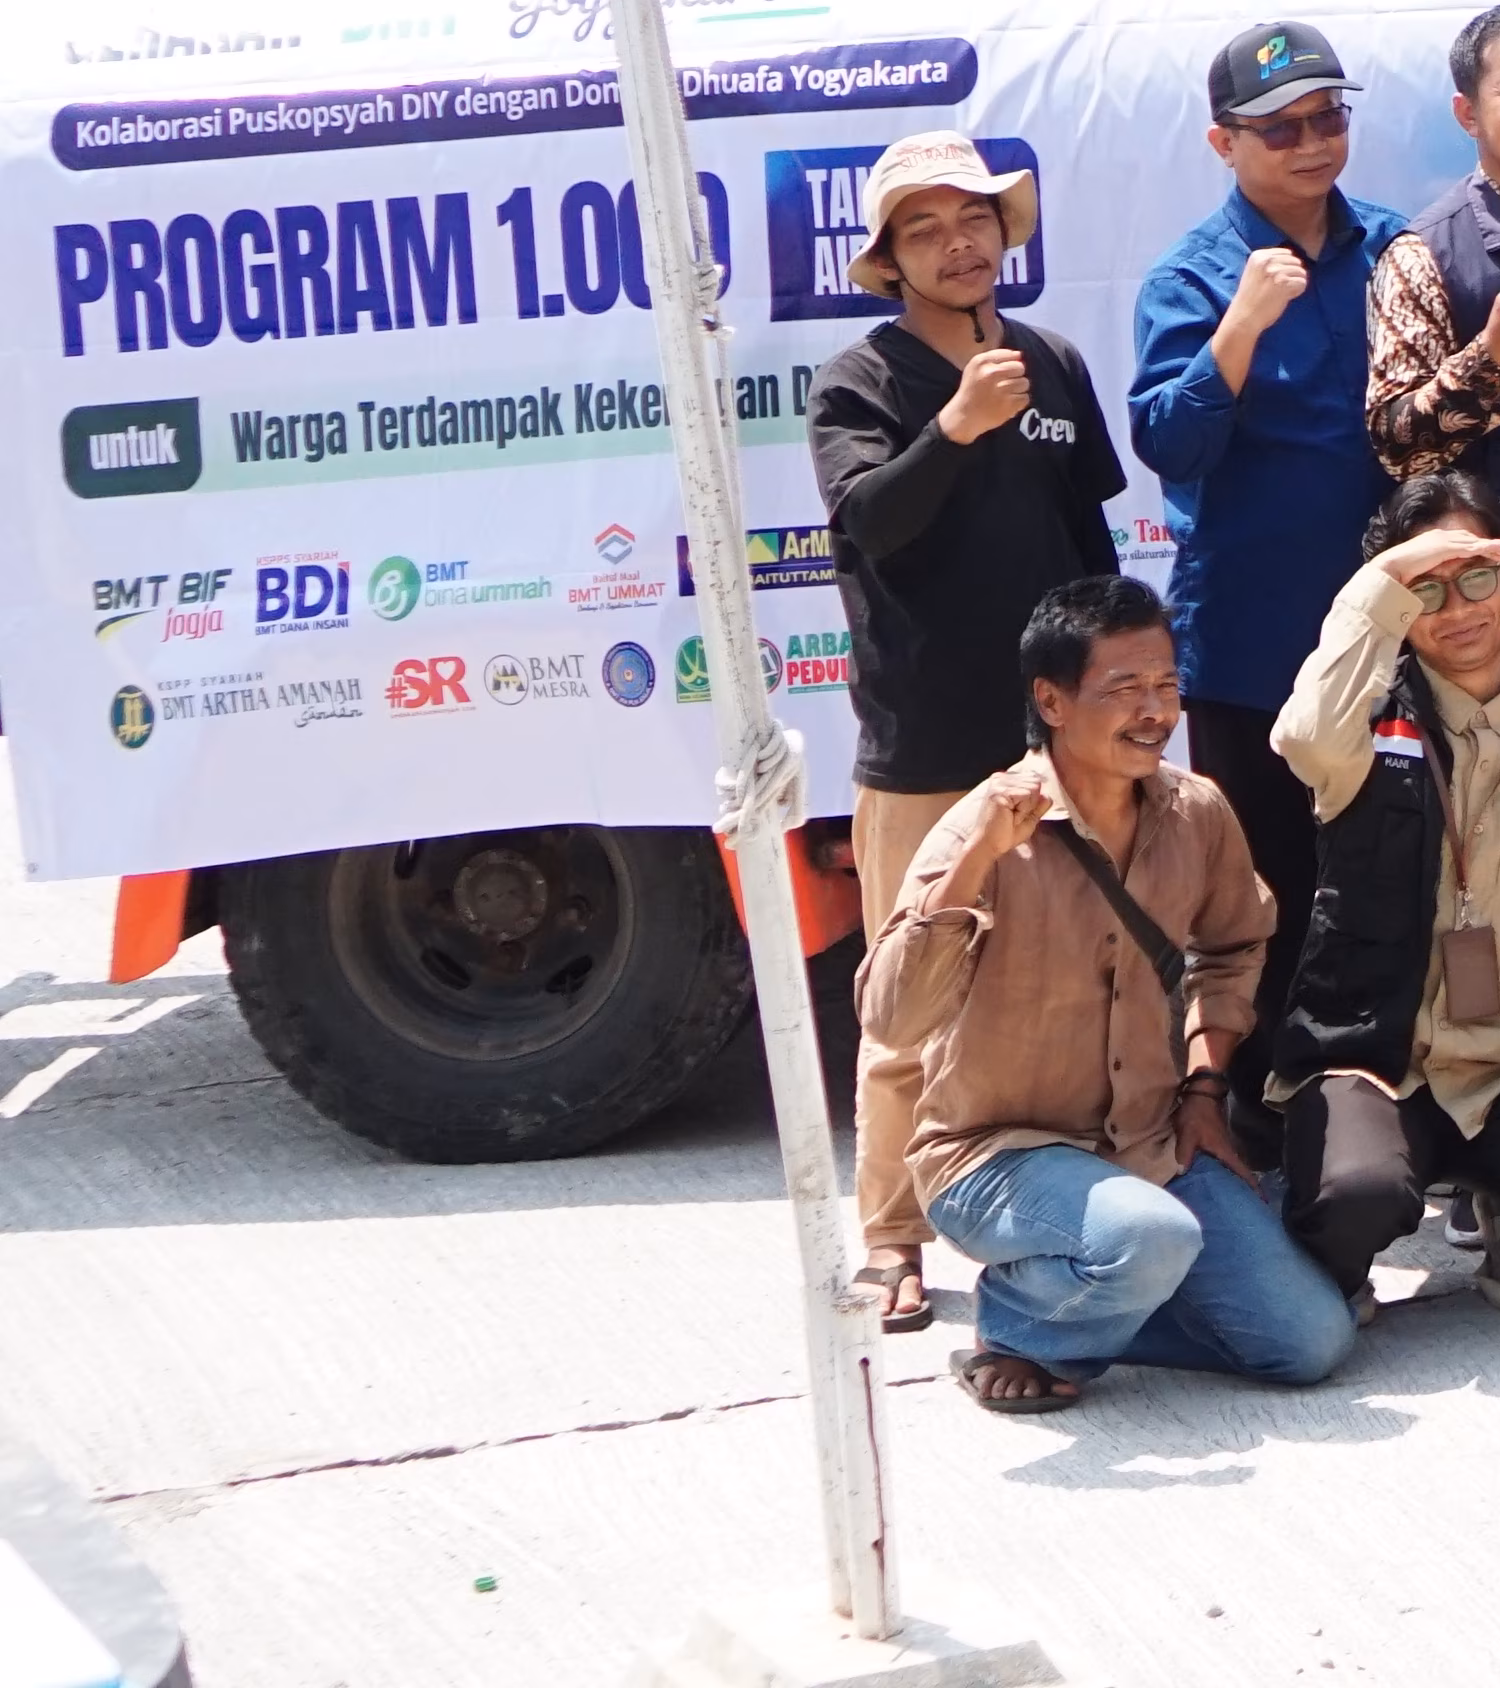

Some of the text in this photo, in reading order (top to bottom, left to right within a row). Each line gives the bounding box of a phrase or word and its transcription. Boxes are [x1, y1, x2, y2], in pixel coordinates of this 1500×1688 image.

[75, 58, 948, 150] Kolaborasi Puskopsyah DIY dengan Dhuafa Yogyakarta
[52, 190, 477, 358] PROGRAM
[229, 402, 350, 466] Warga
[356, 380, 564, 452] Terdampak
[87, 420, 183, 471] untuk
[93, 568, 235, 611] BMT BIF
[254, 560, 351, 624] BDI
[424, 560, 470, 583] BMT
[424, 574, 553, 608] bina ummah
[567, 582, 666, 604] BMT UMMAT
[160, 601, 226, 644] jogja
[530, 652, 586, 681] BMT
[160, 694, 196, 722] BMT
[199, 685, 271, 719] ARTHA
[276, 677, 362, 713] AMANAH
[532, 678, 591, 701] MESRA
